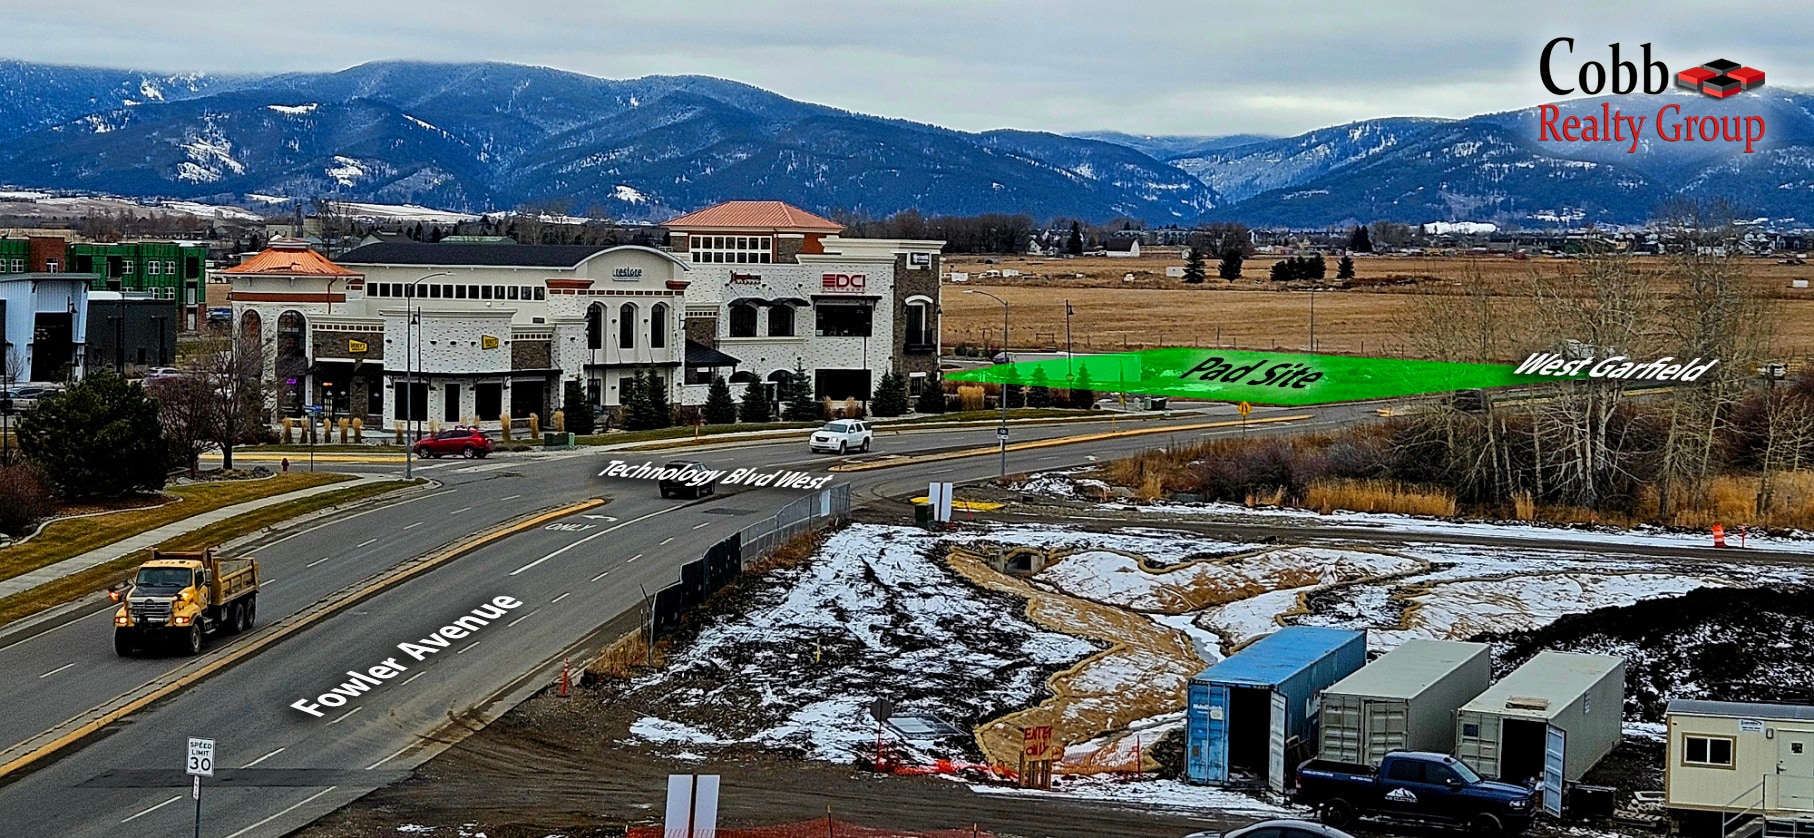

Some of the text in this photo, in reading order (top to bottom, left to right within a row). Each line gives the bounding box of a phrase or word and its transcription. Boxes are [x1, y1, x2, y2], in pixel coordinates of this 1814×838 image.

[545, 523, 597, 532] ONLY
[190, 741, 212, 750] SPEED
[189, 756, 211, 771] 30
